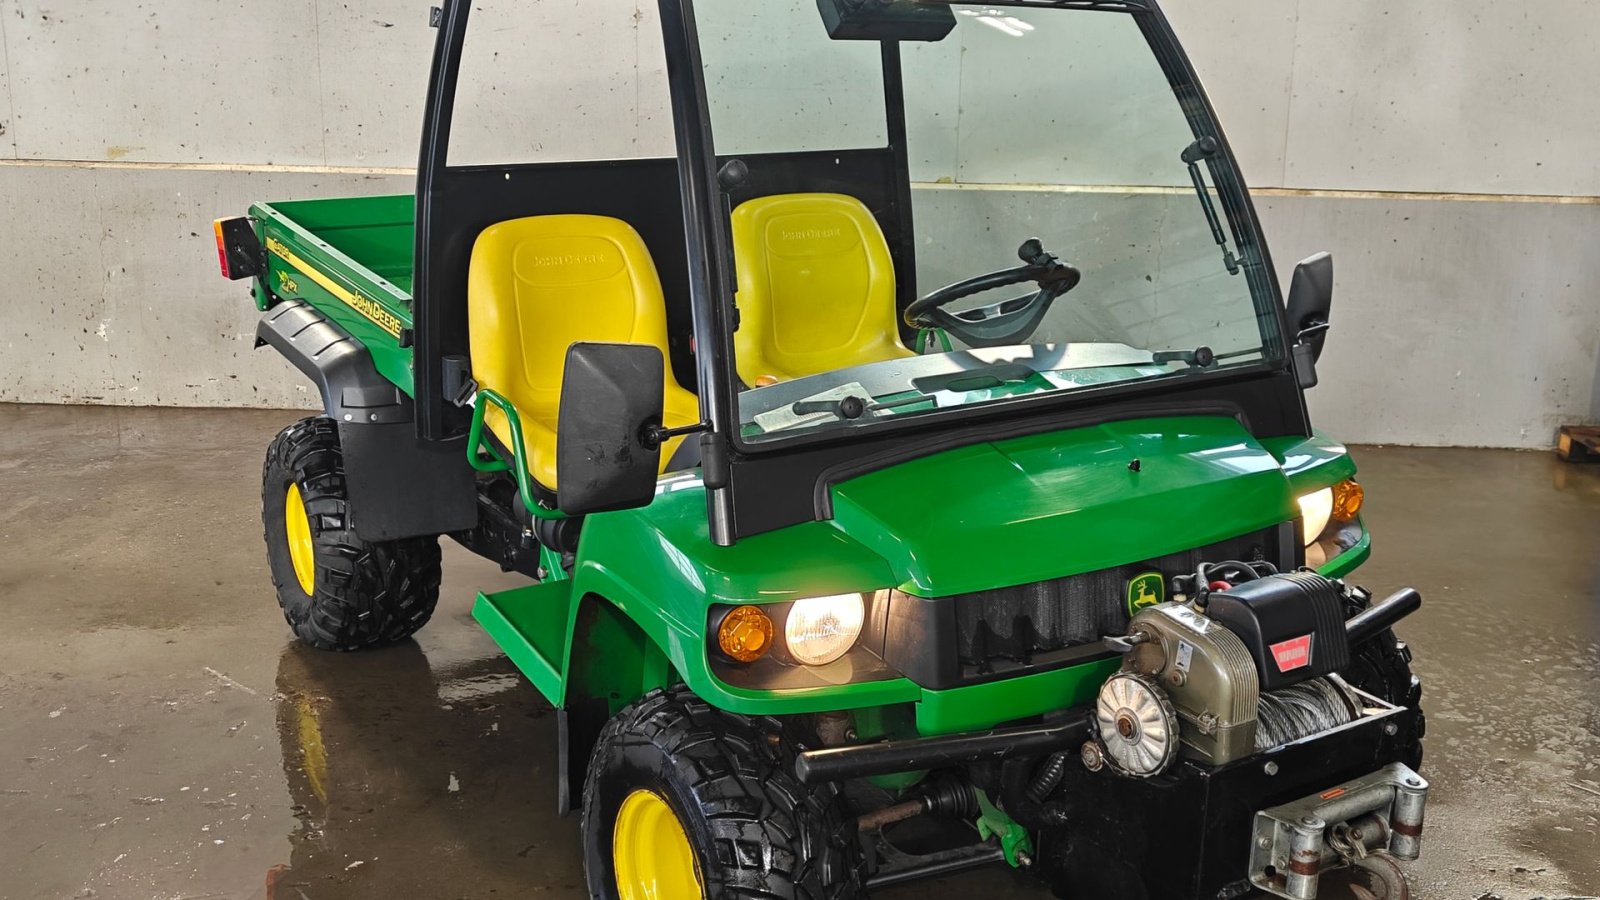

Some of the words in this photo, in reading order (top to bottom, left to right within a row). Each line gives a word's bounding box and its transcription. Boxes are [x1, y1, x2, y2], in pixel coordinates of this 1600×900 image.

[532, 256, 563, 266] JOHN
[352, 290, 373, 317] JOHN
[373, 302, 402, 335] DEERE
